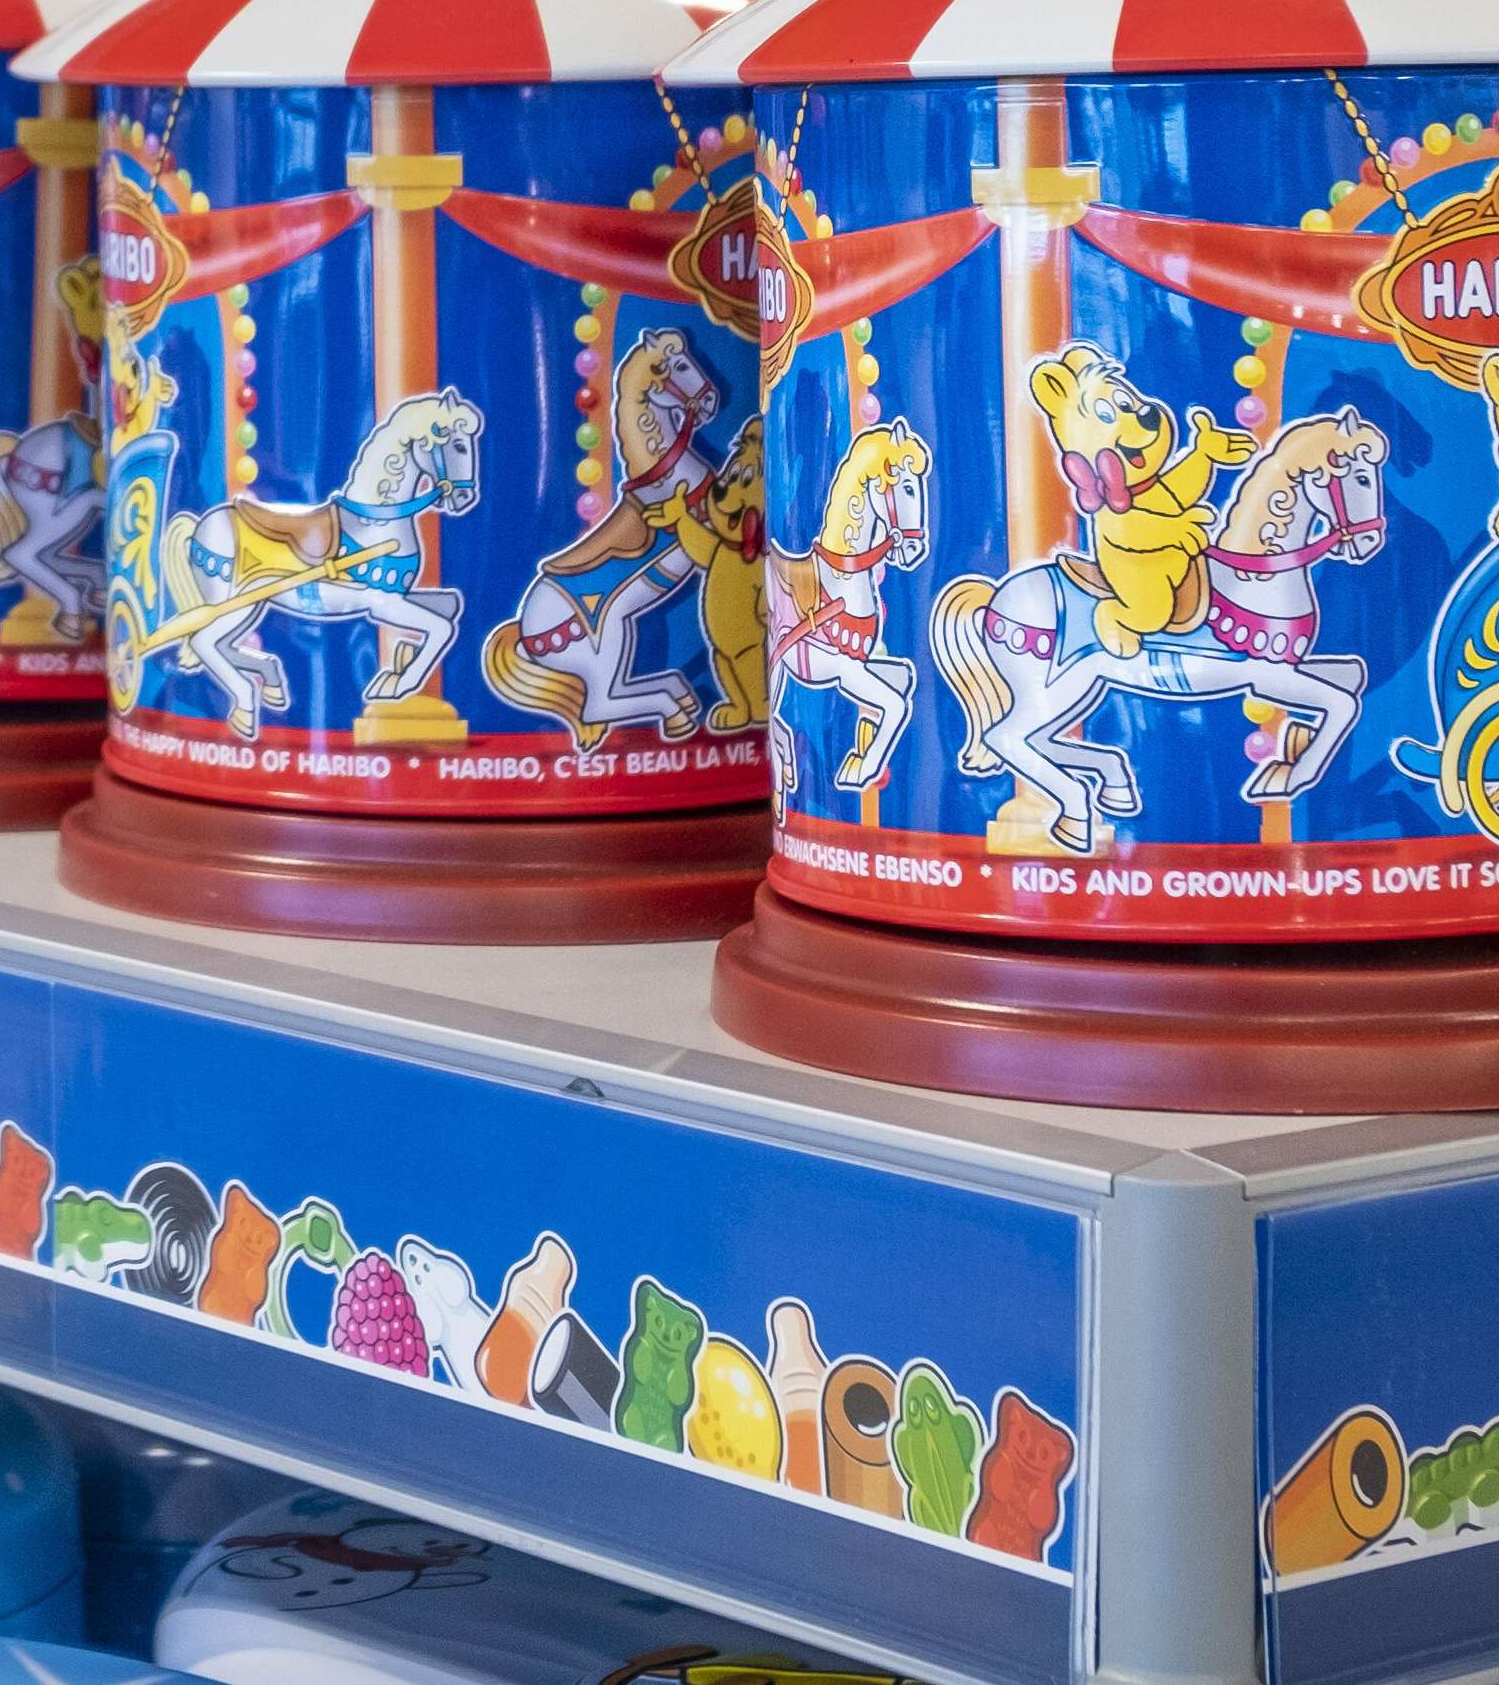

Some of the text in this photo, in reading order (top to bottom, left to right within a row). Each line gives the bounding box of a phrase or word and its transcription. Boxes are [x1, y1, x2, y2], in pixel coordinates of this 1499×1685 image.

[17, 651, 106, 675] KIDS AN
[142, 729, 186, 759] HAPPY
[188, 740, 255, 770] WORLD
[261, 749, 292, 773] OF
[296, 753, 392, 779] HARIBO
[439, 740, 761, 783] HARIBO, C'EST BEAU LA VIE,
[783, 833, 870, 877] ERWACHSENE
[874, 853, 963, 888] EBENSO
[1011, 867, 1078, 895] KIDS
[1085, 870, 1153, 898] AND
[1161, 866, 1363, 899] GROWN-UPS
[1372, 865, 1441, 894] LOVE
[1448, 861, 1473, 889] IT
